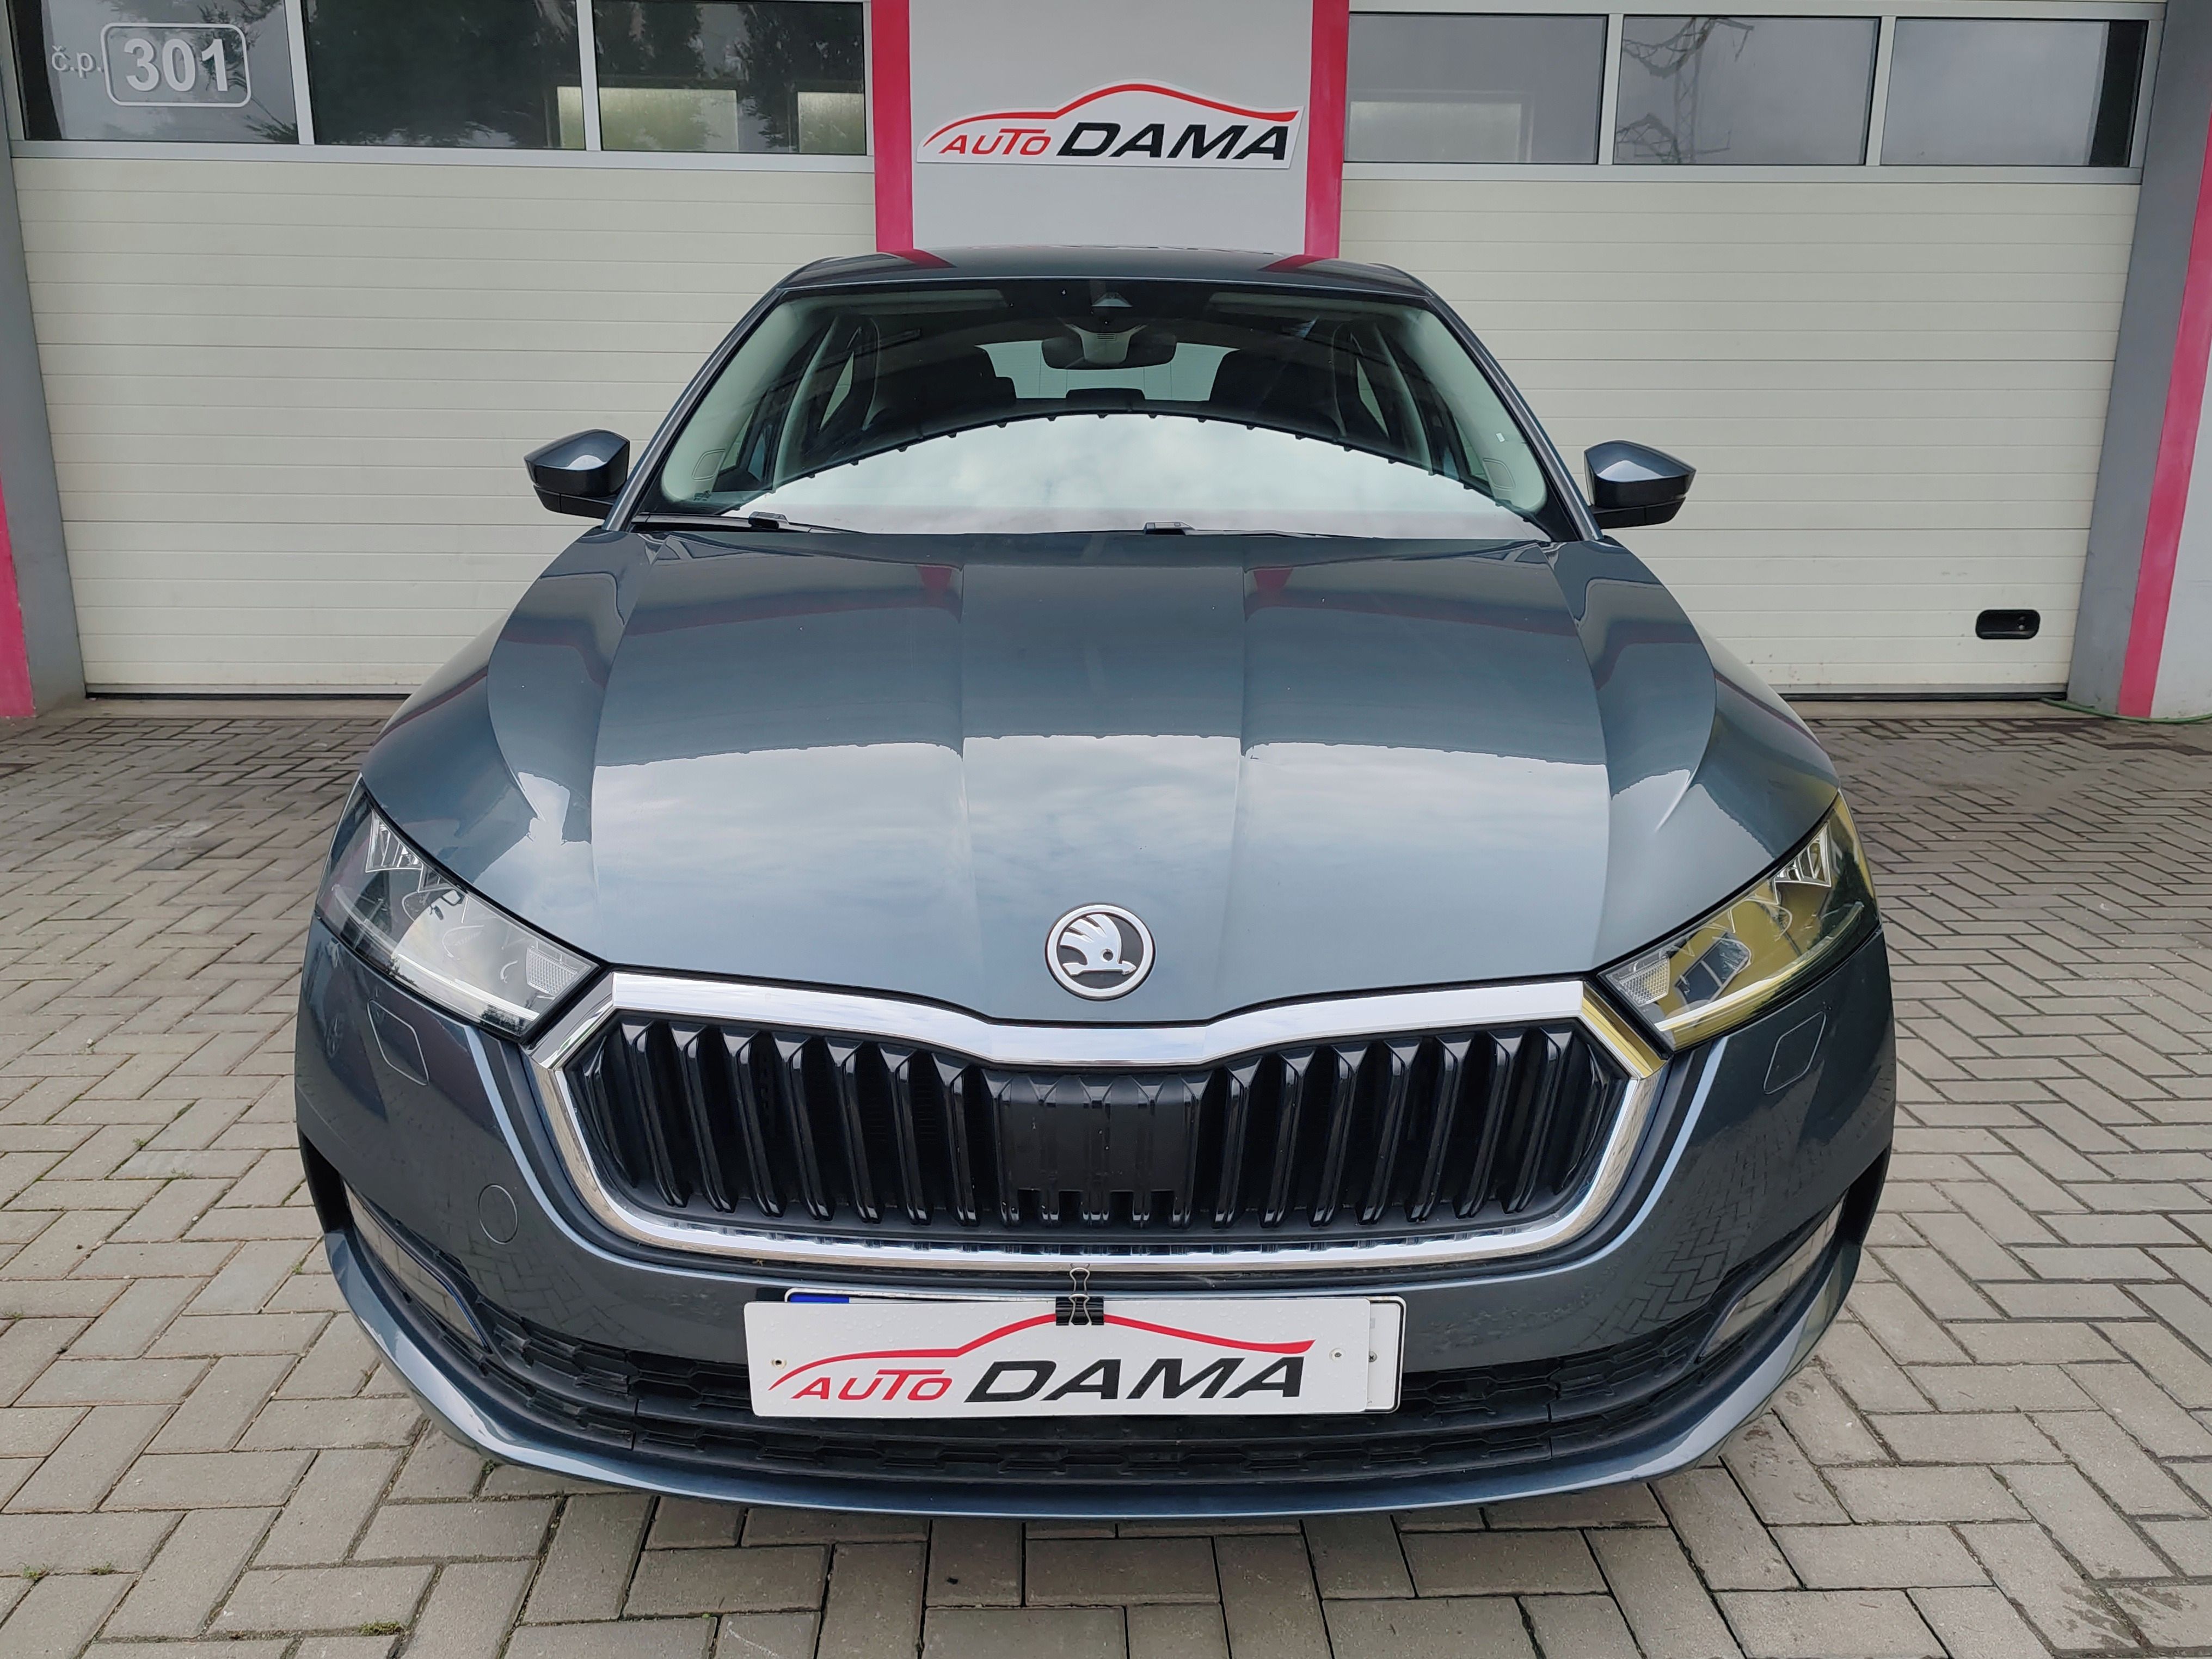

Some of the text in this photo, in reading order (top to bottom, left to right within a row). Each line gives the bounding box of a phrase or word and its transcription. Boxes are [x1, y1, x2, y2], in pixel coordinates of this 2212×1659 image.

[51, 38, 228, 91] č.p. 301
[940, 122, 1289, 161] AUTO DAMA
[792, 1356, 1305, 1403] AUTO DAMA
